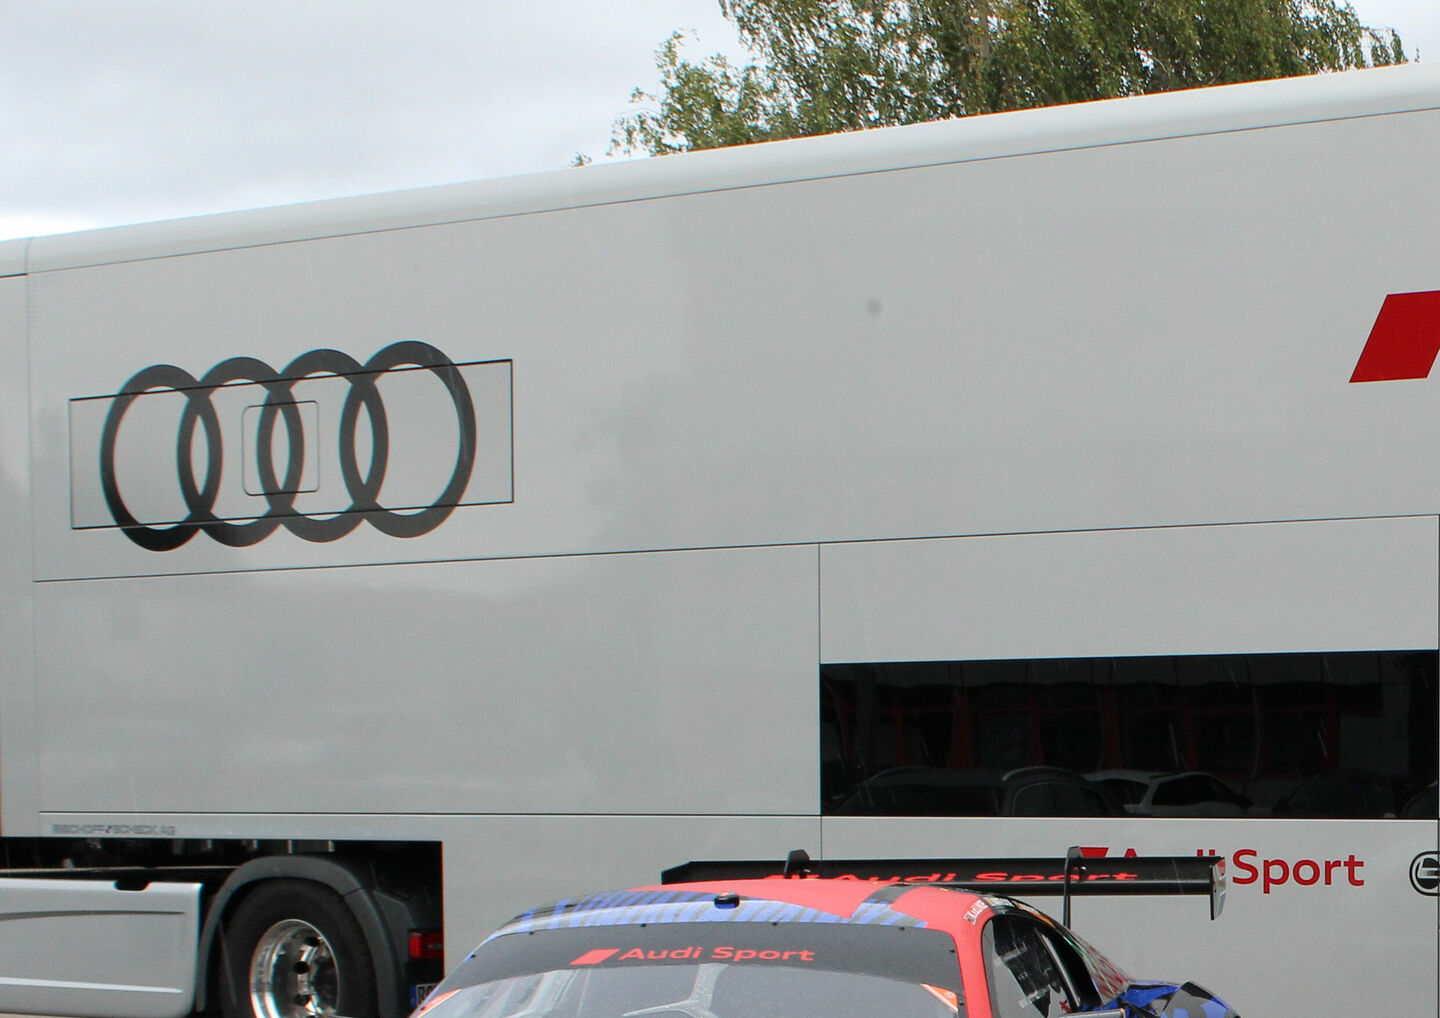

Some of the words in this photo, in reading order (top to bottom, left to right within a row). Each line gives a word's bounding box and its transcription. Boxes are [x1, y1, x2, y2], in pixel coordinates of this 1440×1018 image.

[1232, 849, 1365, 895] Sport
[618, 946, 702, 960] Audi
[711, 946, 815, 961] Sport
